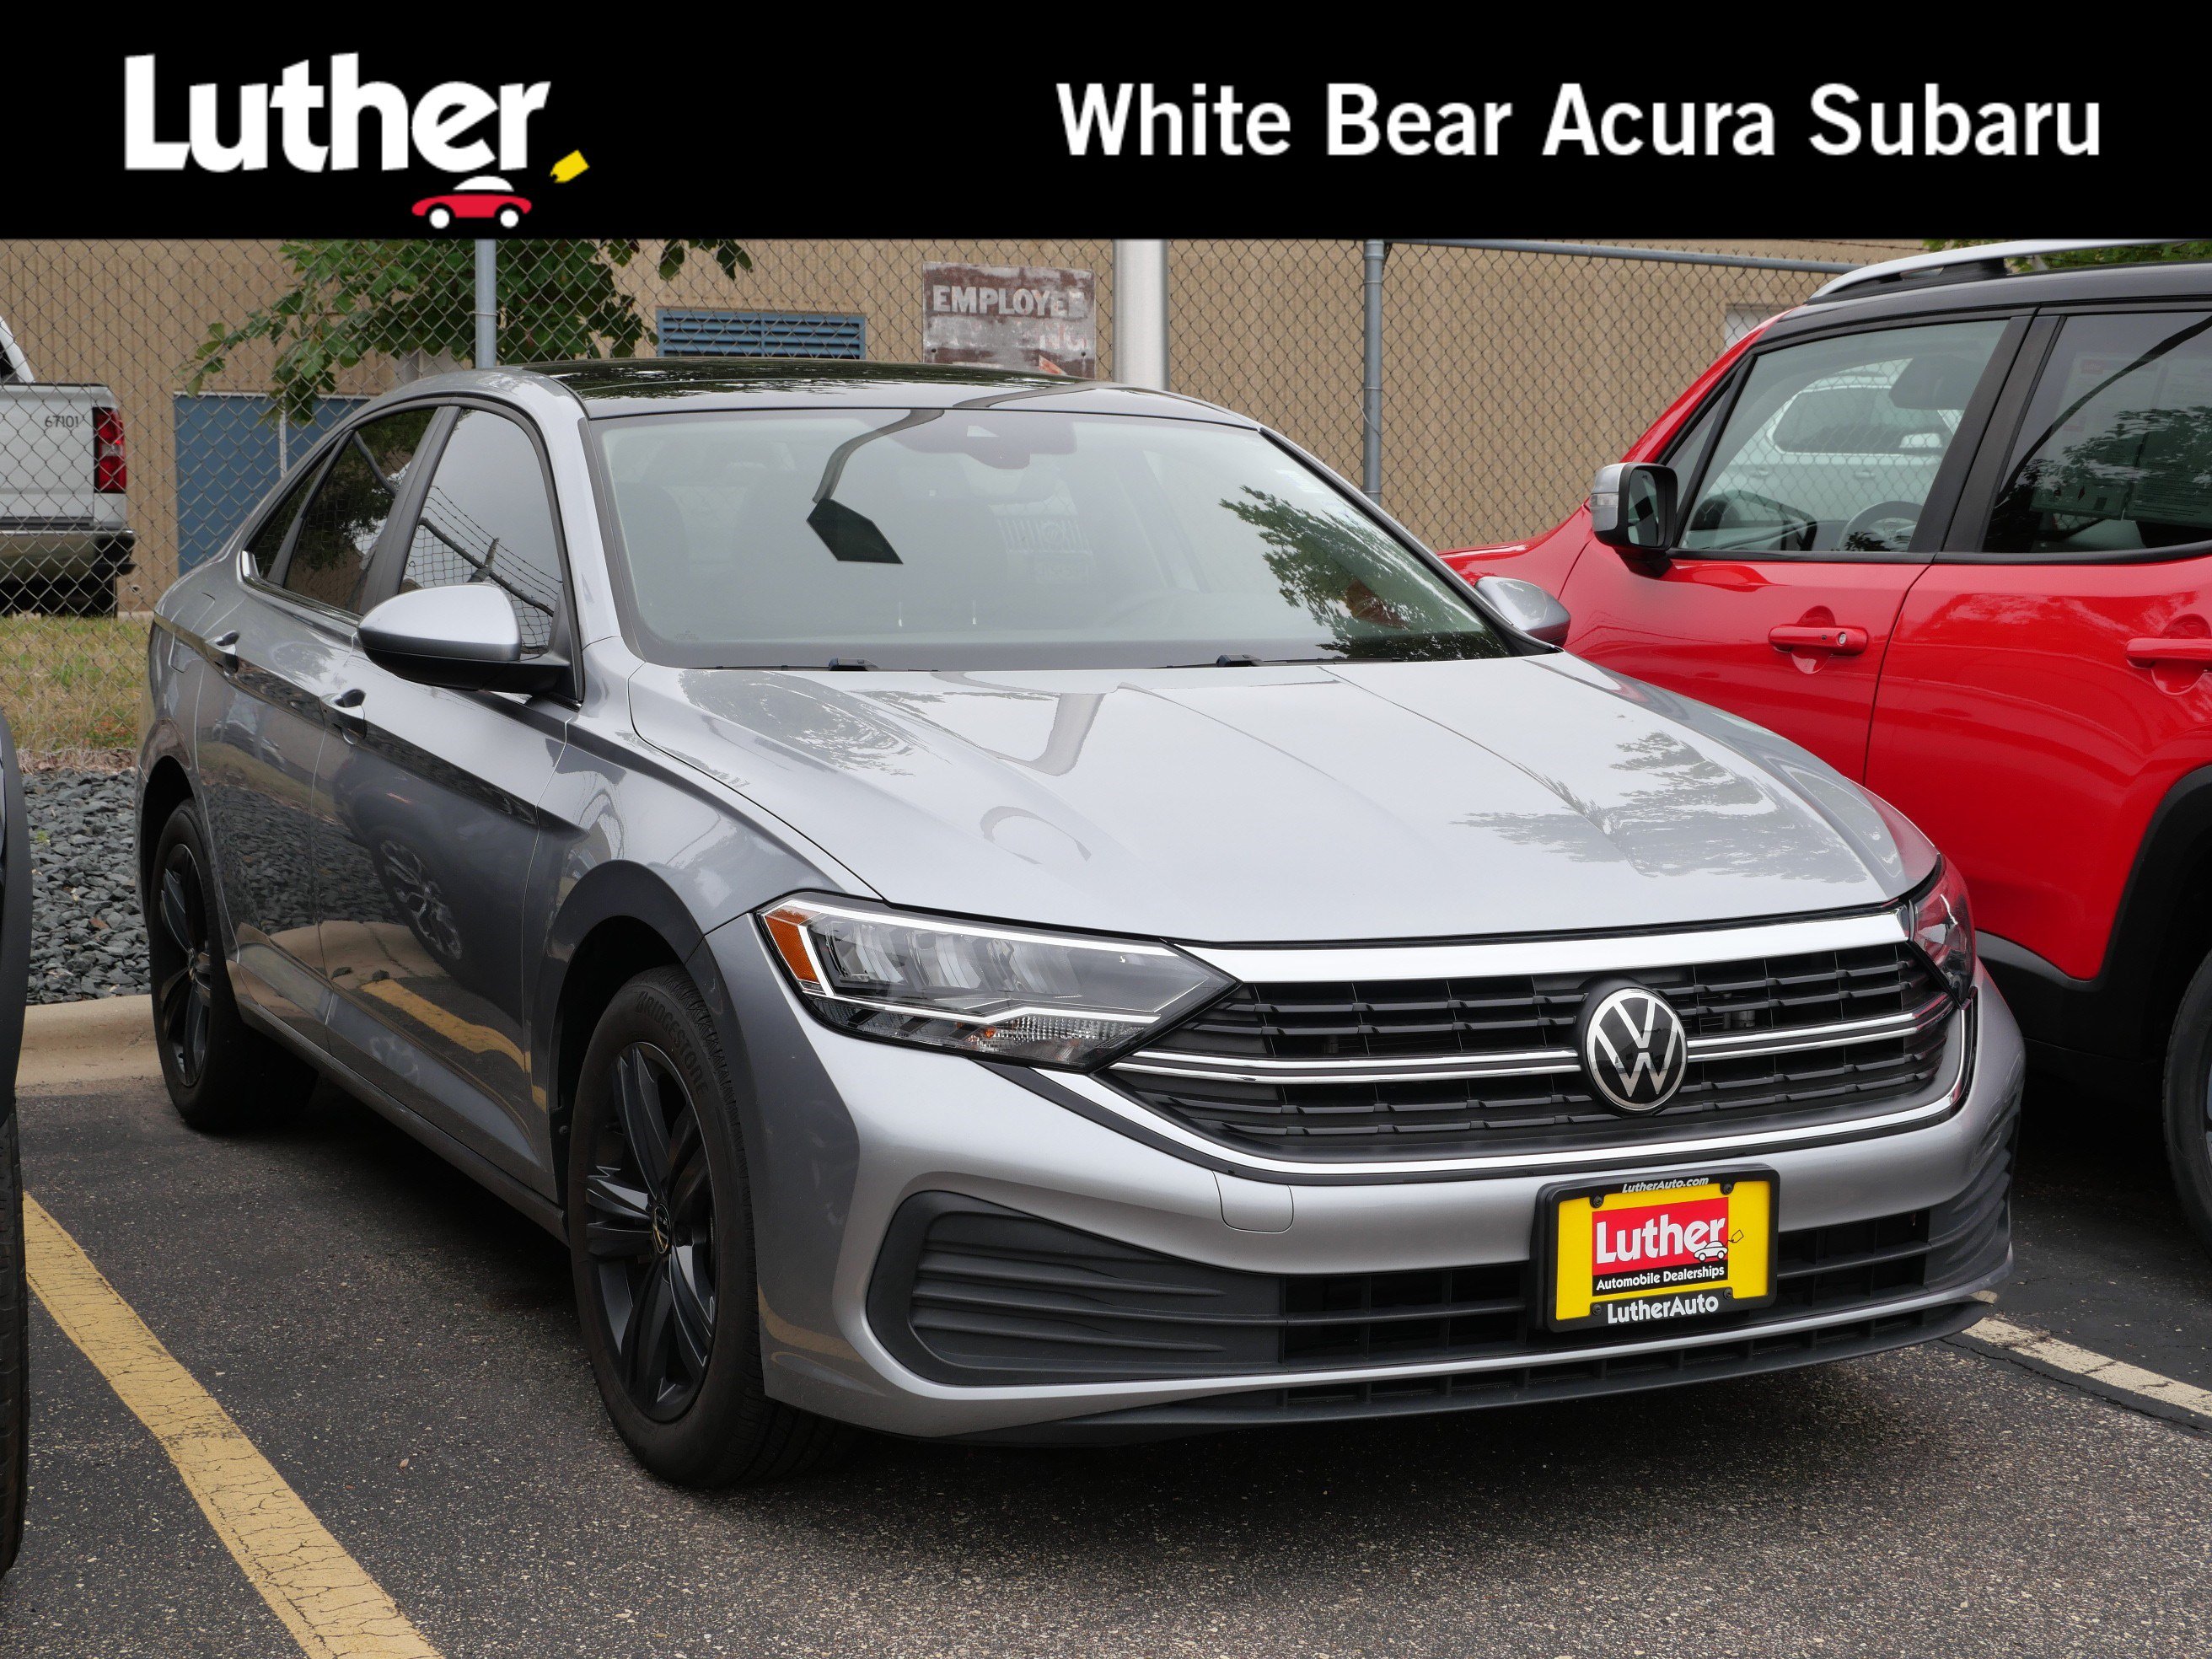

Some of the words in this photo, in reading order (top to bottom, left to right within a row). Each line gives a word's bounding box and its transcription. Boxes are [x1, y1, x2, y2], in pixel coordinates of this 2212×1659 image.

[45, 415, 79, 427] 67101
[1622, 1176, 1709, 1193] LutherAuto.com
[1596, 1214, 1726, 1264] Luther
[1596, 1273, 1660, 1291] Automobile
[1663, 1265, 1725, 1282] Dealerships
[1608, 1294, 1719, 1323] LutherAuto
